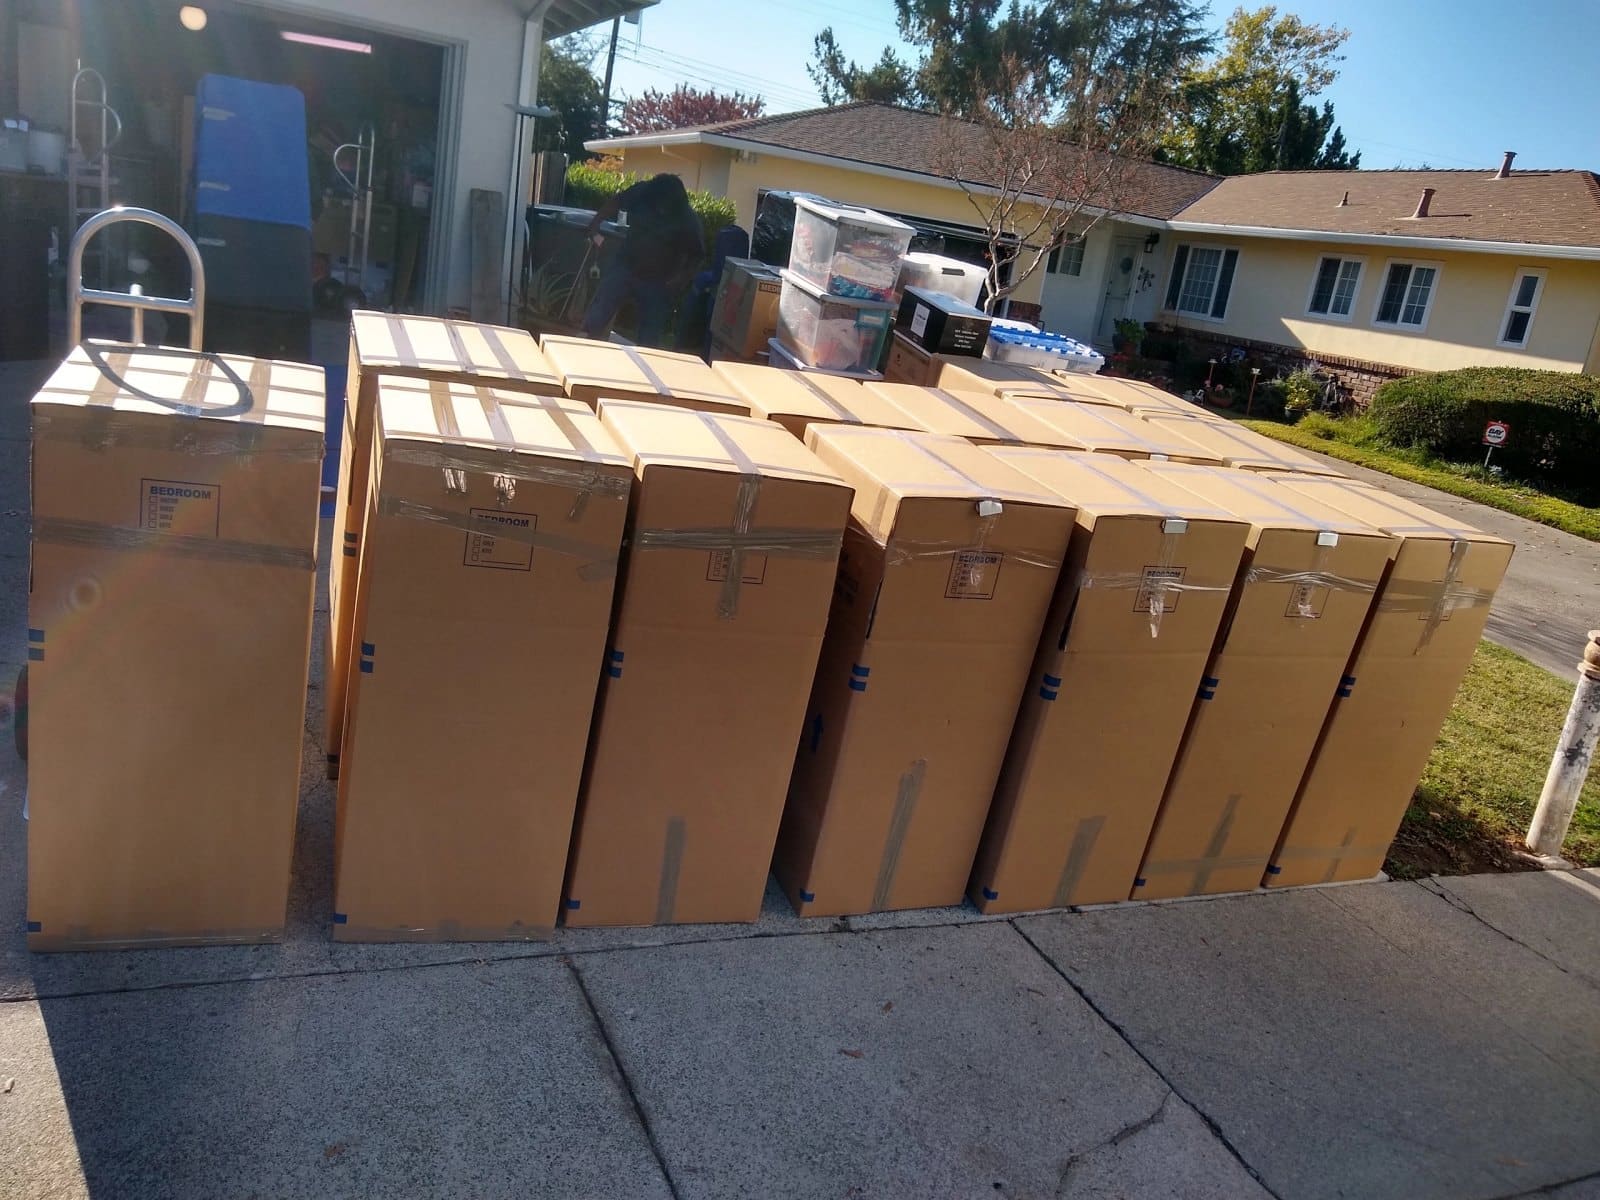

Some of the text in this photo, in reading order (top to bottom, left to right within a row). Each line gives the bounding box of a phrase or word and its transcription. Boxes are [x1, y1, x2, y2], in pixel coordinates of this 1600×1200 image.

[761, 283, 781, 293] MEDI
[149, 485, 211, 499] BEDROOM
[478, 514, 529, 528] ROOM
